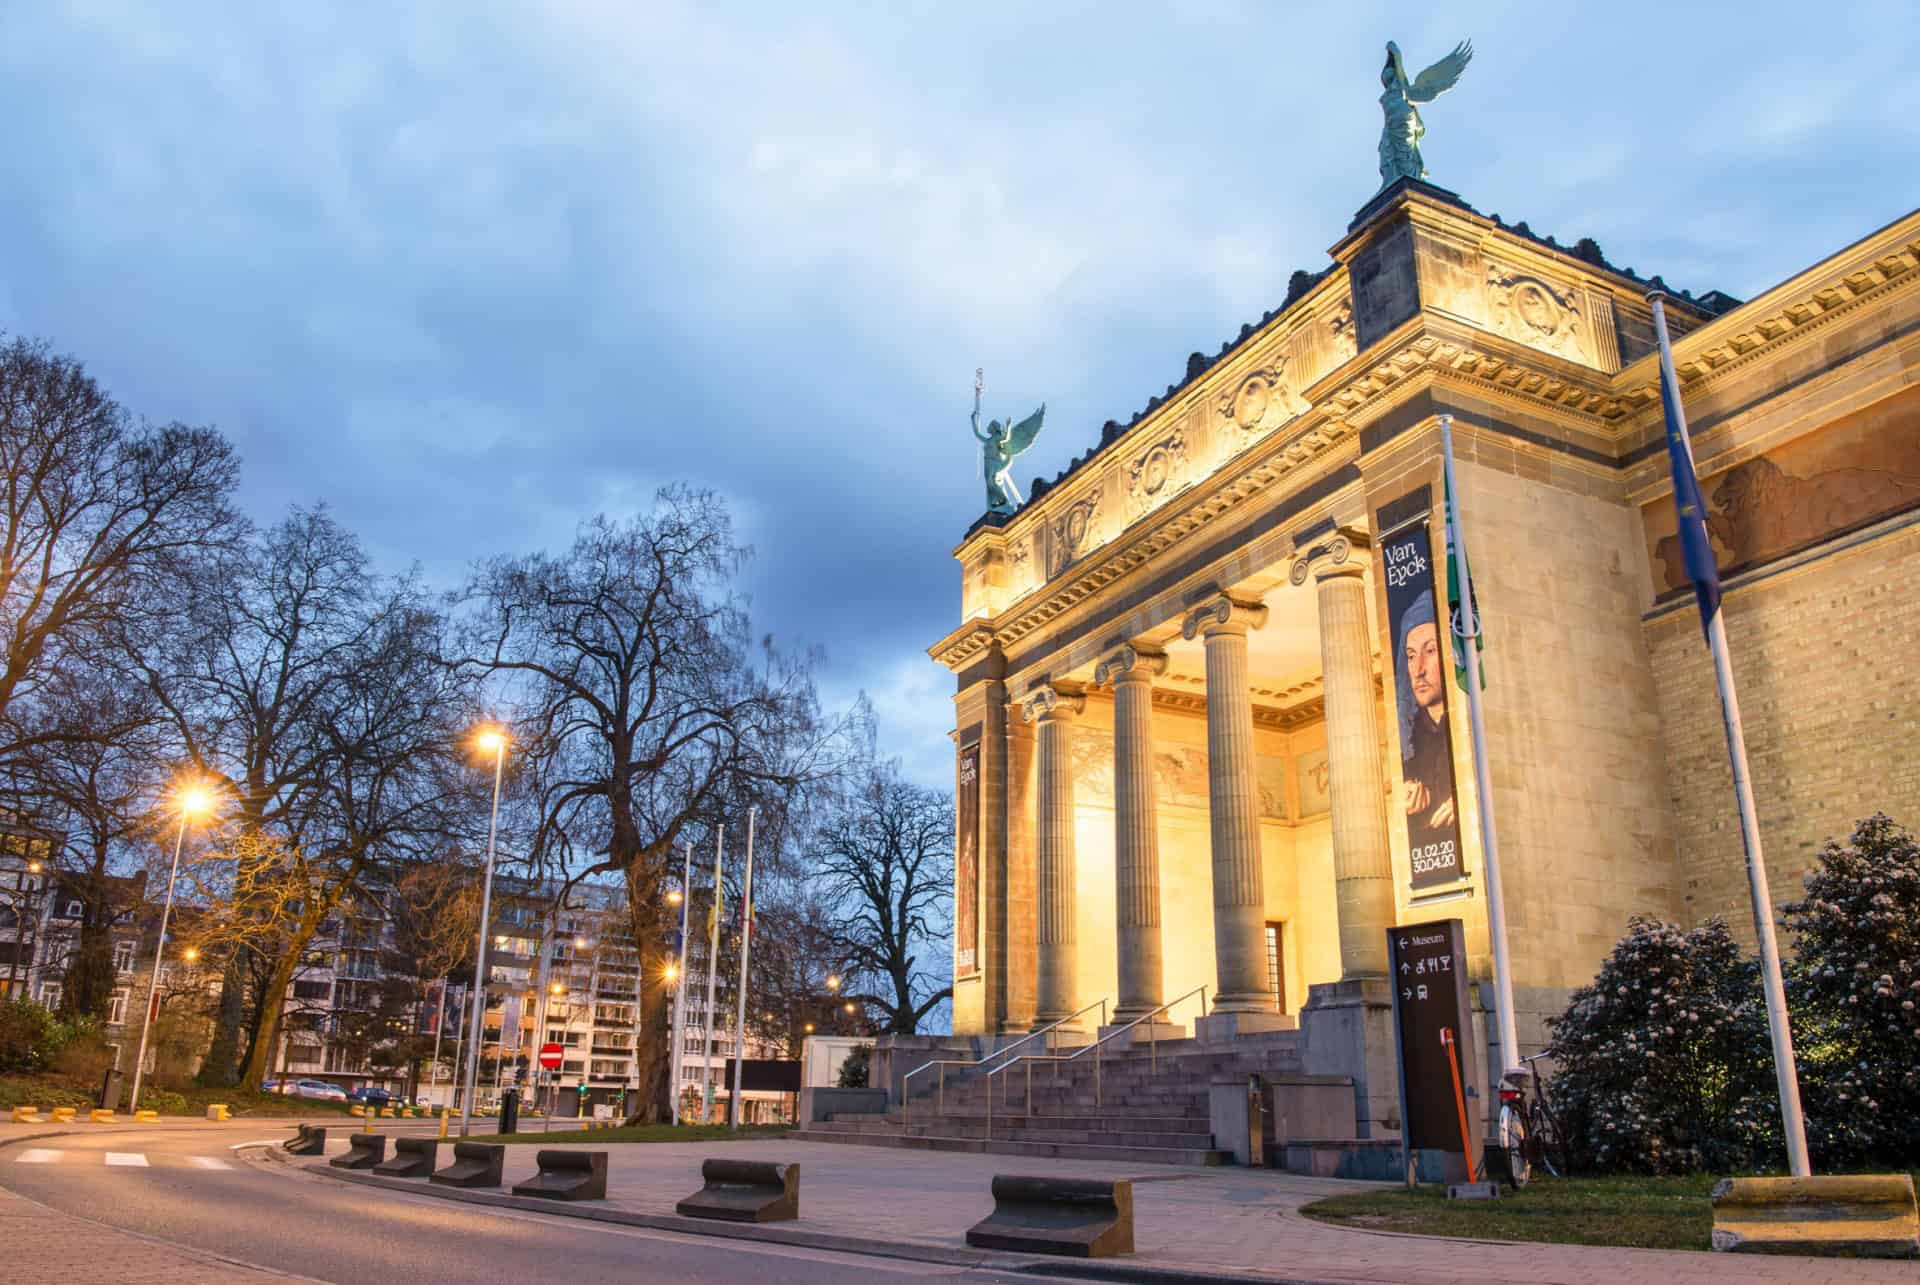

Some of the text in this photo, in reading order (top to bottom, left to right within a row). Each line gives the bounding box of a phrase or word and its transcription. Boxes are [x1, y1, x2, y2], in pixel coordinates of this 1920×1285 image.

[1385, 543, 1416, 565] Van
[1388, 554, 1427, 586] Eyck
[1411, 934, 1445, 946] Museum
